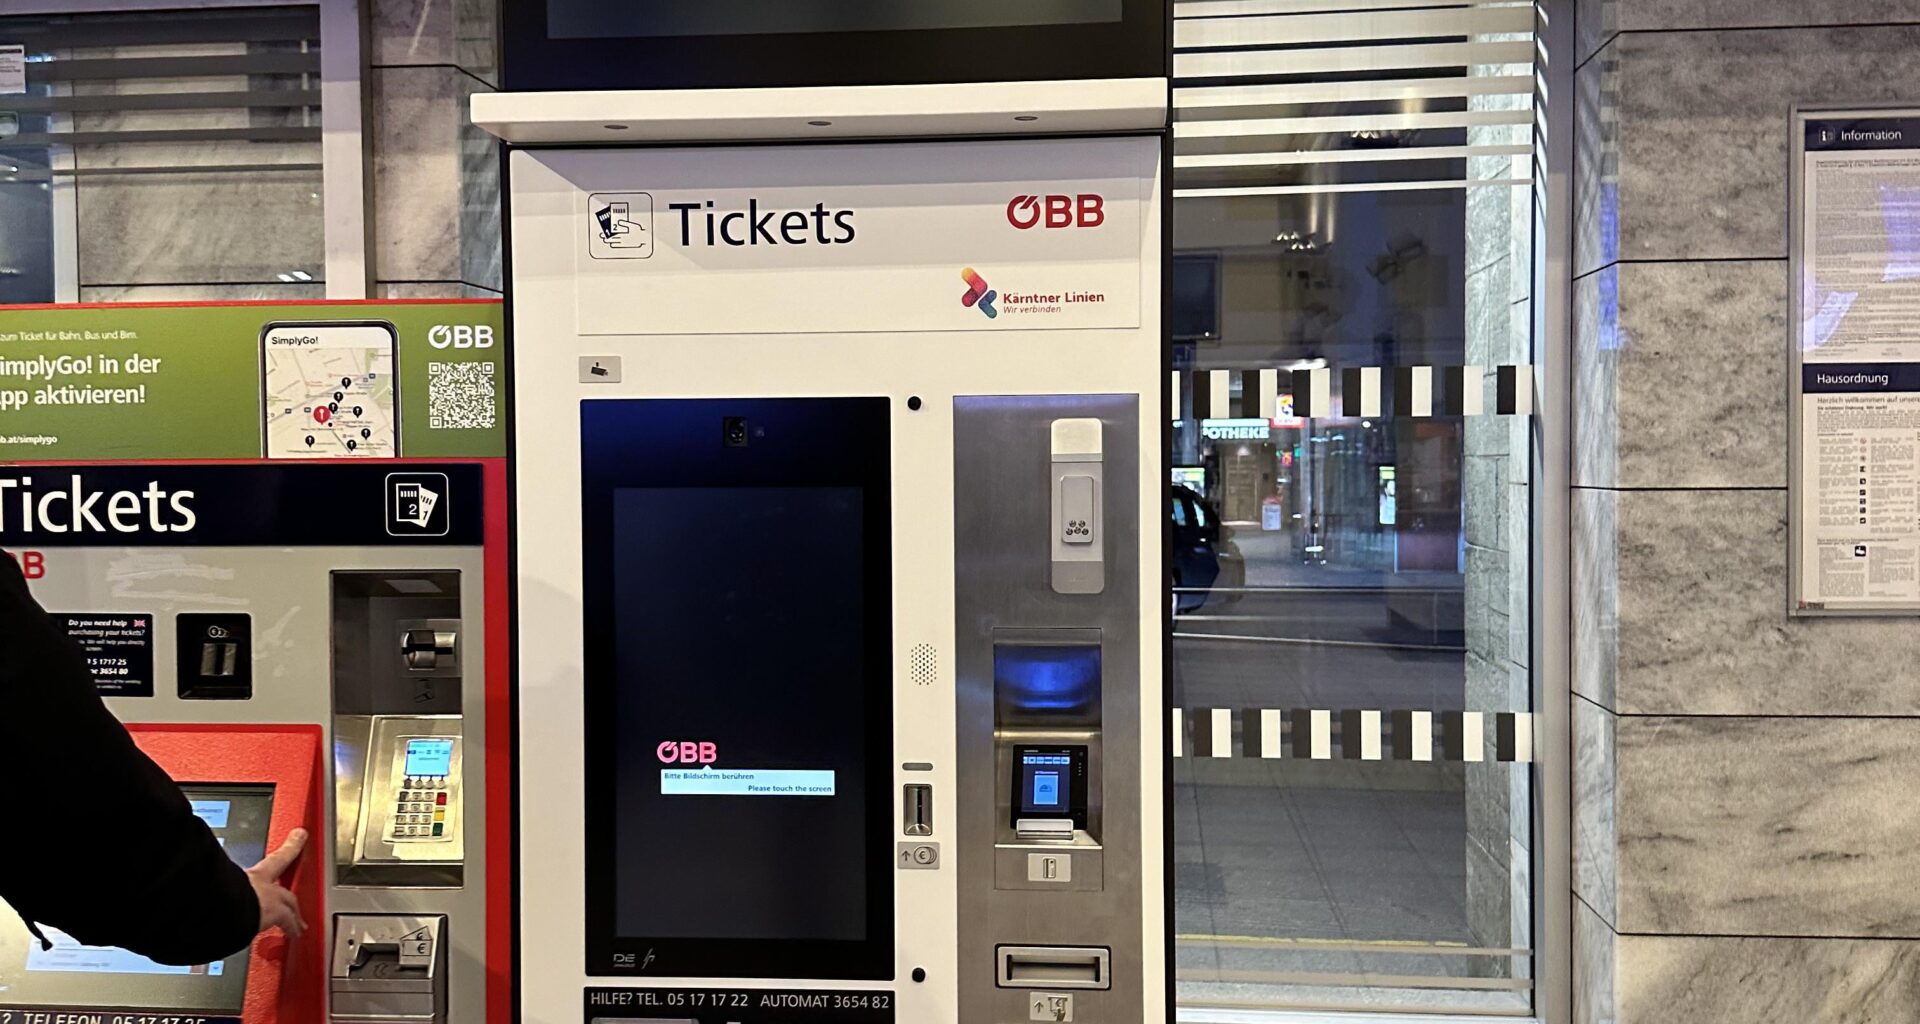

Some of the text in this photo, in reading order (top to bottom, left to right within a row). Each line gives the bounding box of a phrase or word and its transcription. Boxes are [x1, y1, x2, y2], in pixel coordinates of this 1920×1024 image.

[1841, 130, 1902, 141] Information
[1007, 194, 1105, 229] ÖBB
[669, 199, 856, 246] Tickets
[1003, 292, 1105, 304] Kärntner Linien
[1020, 305, 1062, 313] verbinden
[19, 331, 43, 341] Ticket
[85, 330, 100, 340] Bus
[102, 330, 118, 340] und
[120, 330, 138, 340] Bim.
[271, 336, 319, 346] SimplyGo!
[428, 325, 494, 349] ÖBB
[0, 353, 161, 380] implyGo! in der
[1817, 373, 1889, 386] Hausordnung
[0, 384, 145, 411] pp aktivieren!
[0, 474, 197, 533] Tickets
[112, 620, 128, 628] help
[657, 741, 717, 763] ÖBB
[591, 992, 889, 1008] HILFE? TEL. 05 17 17 22 AUTOMAT 3654 82
